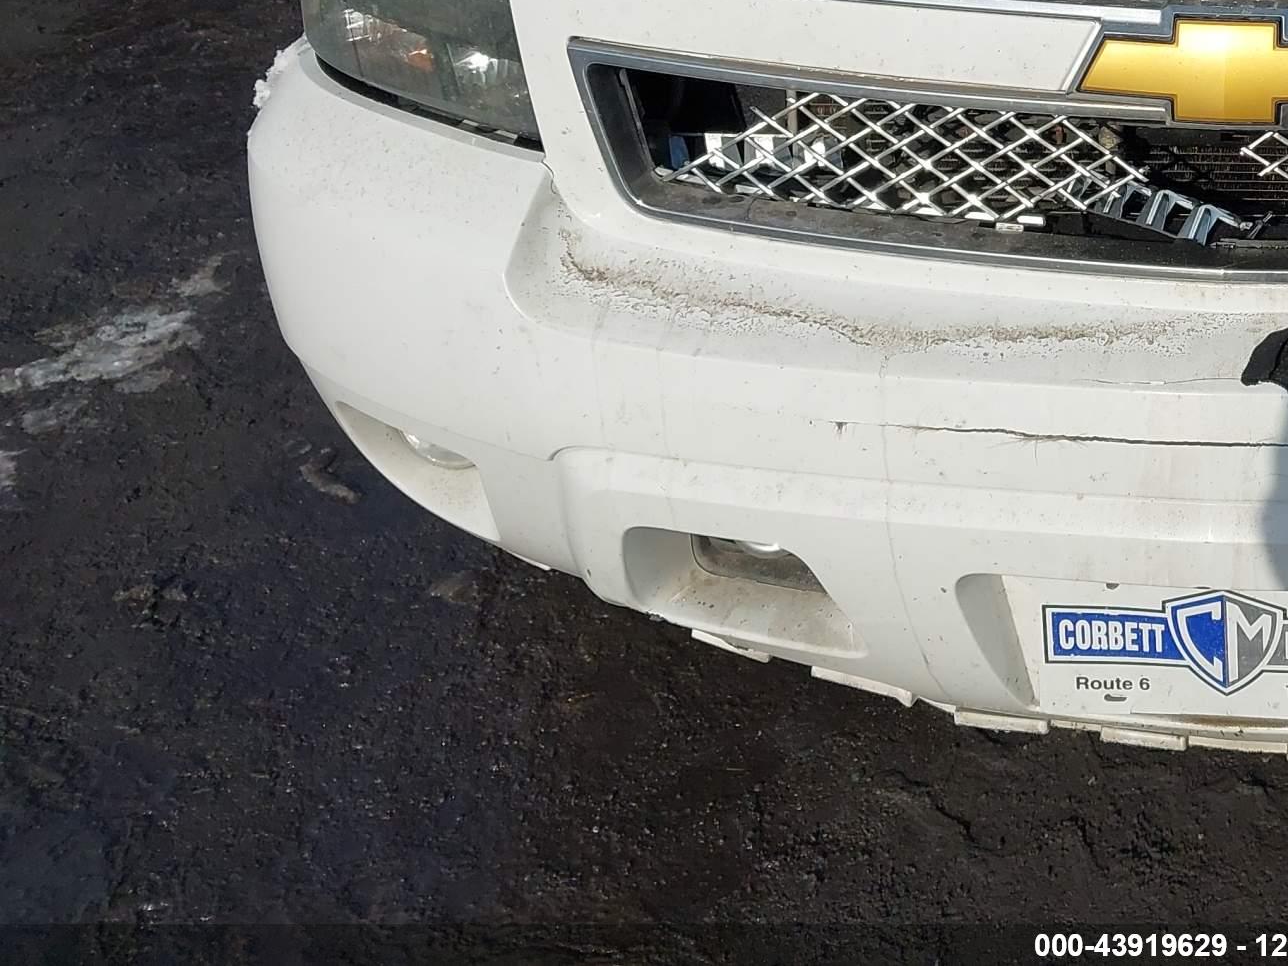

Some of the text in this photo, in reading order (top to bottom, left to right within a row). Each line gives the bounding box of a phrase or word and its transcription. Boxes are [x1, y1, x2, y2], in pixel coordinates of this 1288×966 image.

[1059, 619, 1165, 652] CORBETT
[1076, 676, 1150, 690] Route 6
